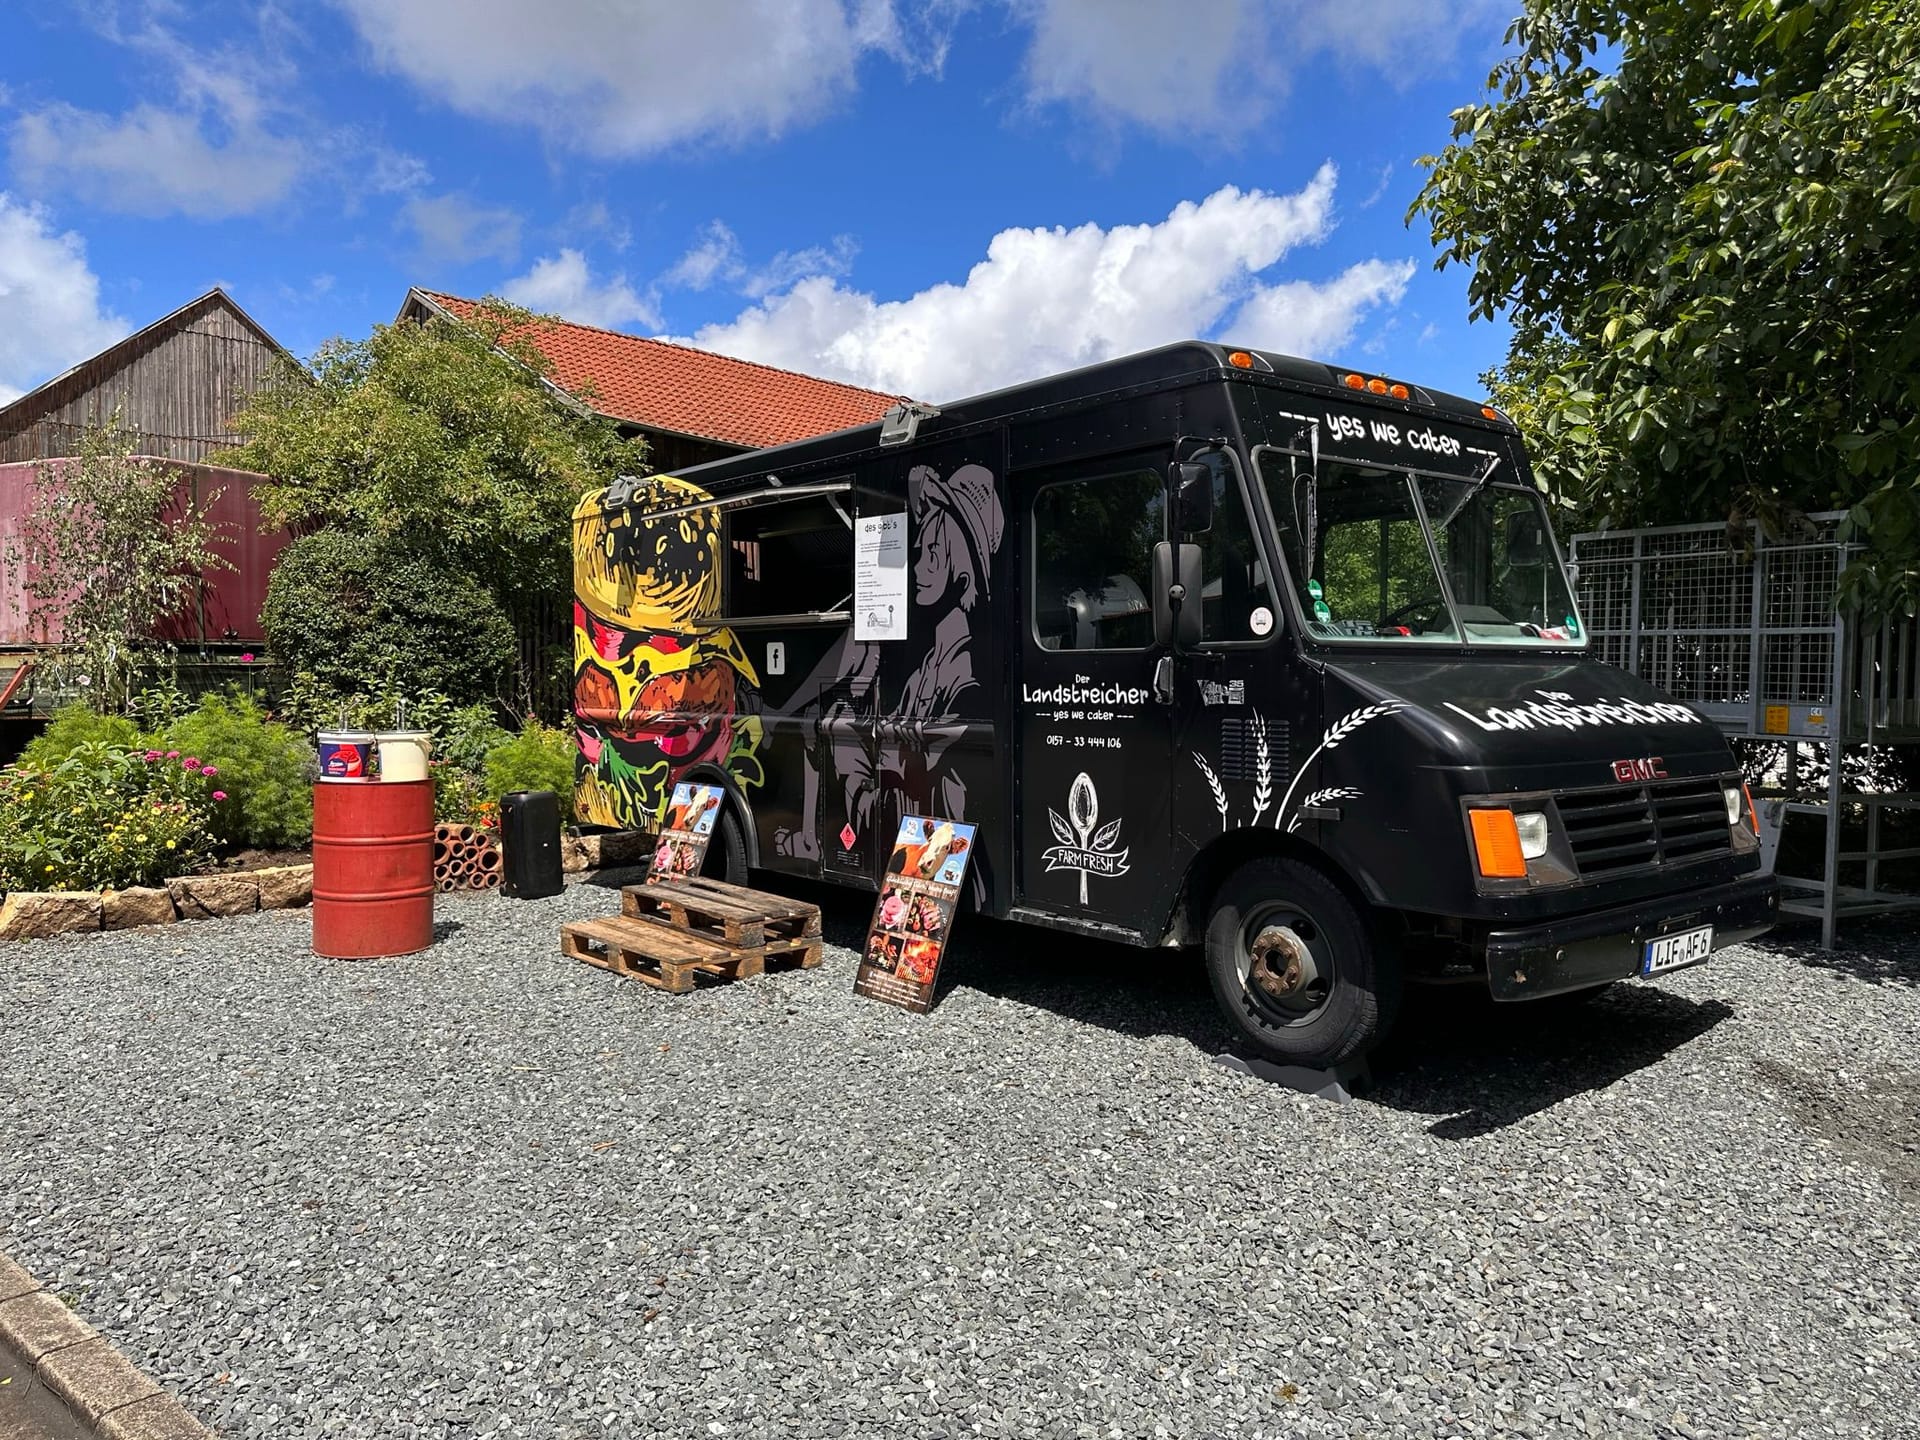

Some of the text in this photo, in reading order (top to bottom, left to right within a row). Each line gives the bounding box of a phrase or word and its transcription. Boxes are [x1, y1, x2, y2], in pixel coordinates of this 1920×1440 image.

[1325, 412, 1461, 457] yes we cater
[1075, 674, 1090, 684] Der
[1023, 682, 1149, 705] Landstreicher
[1053, 709, 1114, 722] yes we cater
[1442, 696, 1702, 732] Landstreicher
[1046, 735, 1064, 746] 0157
[1074, 736, 1085, 747] 33
[1087, 737, 1105, 748] 444
[1107, 737, 1122, 749] 106
[1610, 757, 1669, 784] GMC
[1058, 849, 1113, 873] FARM FRESH
[1655, 938, 1680, 967] LIF
